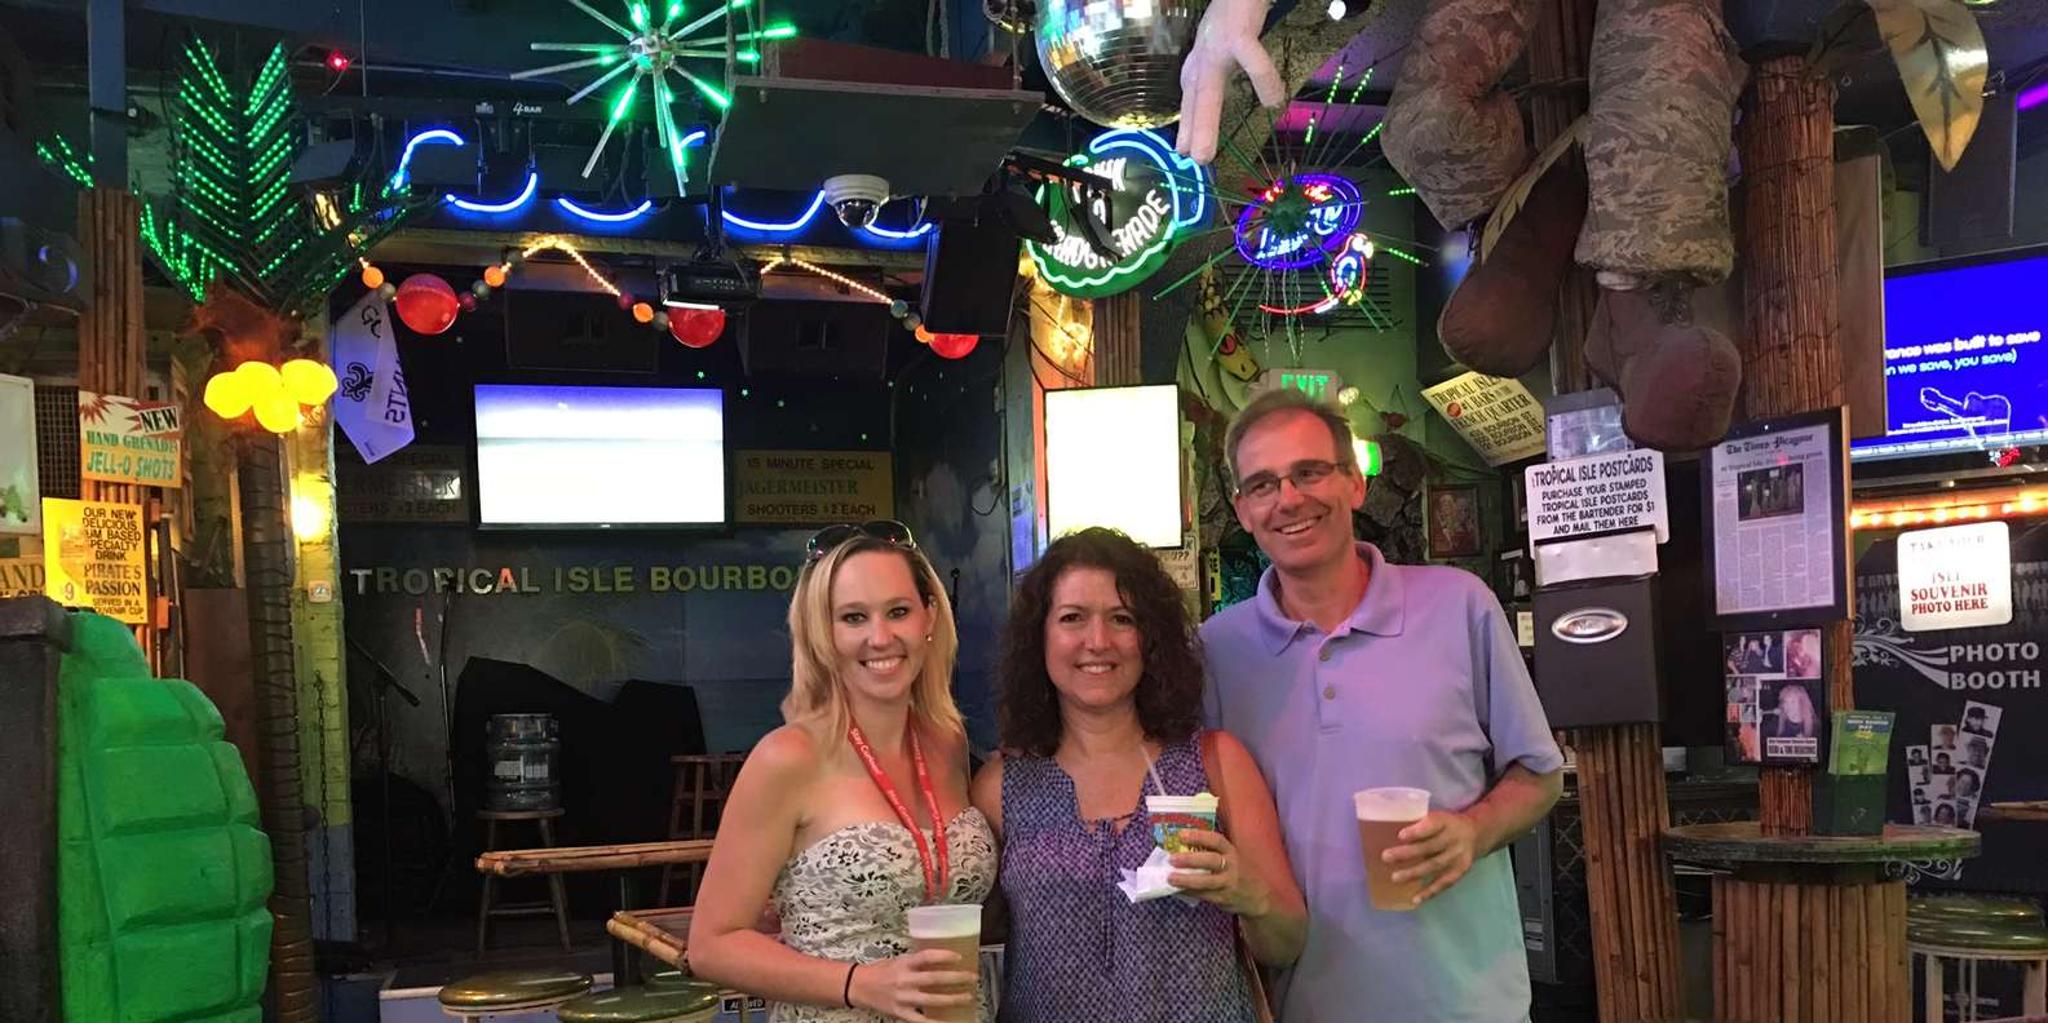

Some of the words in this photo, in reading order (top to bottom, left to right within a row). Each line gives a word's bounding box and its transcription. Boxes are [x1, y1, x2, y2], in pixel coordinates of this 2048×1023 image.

[1923, 341, 1953, 355] was
[1953, 334, 1987, 352] built
[1988, 334, 2005, 347] to
[2005, 330, 2042, 346] save
[1898, 364, 1918, 375] we
[1919, 359, 1953, 372] save,
[1955, 355, 1979, 371] you
[1981, 347, 2018, 365] save)
[1432, 382, 1476, 405] TROPICAL
[1469, 389, 1498, 408] BARS
[1483, 393, 1532, 421] QUARTER
[140, 407, 178, 433] NEW
[86, 430, 120, 447] HAND
[86, 451, 132, 475] JELL-O
[135, 456, 177, 480] SHOTS
[766, 458, 815, 470] MINUTE
[821, 458, 875, 470] SPECIAL
[1534, 466, 1577, 487] TROPICAL
[1578, 464, 1597, 482] ISLE
[1599, 456, 1654, 480] POSTCARDS
[1541, 486, 1582, 501] PURCHASE
[1585, 482, 1608, 495] YOUR
[1609, 478, 1647, 493] STAMPED
[747, 503, 817, 516] SHOOTERS
[841, 503, 877, 516] EACH
[1541, 500, 1579, 512] TROPICAL
[1581, 497, 1598, 508] ISLE
[1600, 489, 1649, 504] POSTCARDS
[83, 506, 106, 518] OUR
[1536, 515, 1559, 526] FROM
[1562, 511, 1577, 522] THE
[1579, 507, 1625, 521] BARTENDER
[1627, 503, 1644, 515] FOR
[1645, 501, 1655, 513] $1
[82, 517, 138, 531] DELICIOUS
[1553, 524, 1570, 535] AND
[1572, 521, 1592, 532] MAIL
[1593, 518, 1616, 529] THEM
[1618, 515, 1639, 527] HERE
[106, 531, 142, 542] BASED
[94, 549, 127, 561] DRINK
[85, 580, 140, 596] PASSION
[350, 566, 541, 595] TROPICAL
[553, 566, 635, 593] ISLE
[649, 564, 800, 592] BOURBO
[1910, 582, 1989, 602] SOUVENIR
[1911, 601, 1952, 616] PHOTO
[1954, 598, 1989, 612] HERE
[1950, 642, 2039, 663] PHOTO
[1951, 669, 2041, 690] BOOTH
